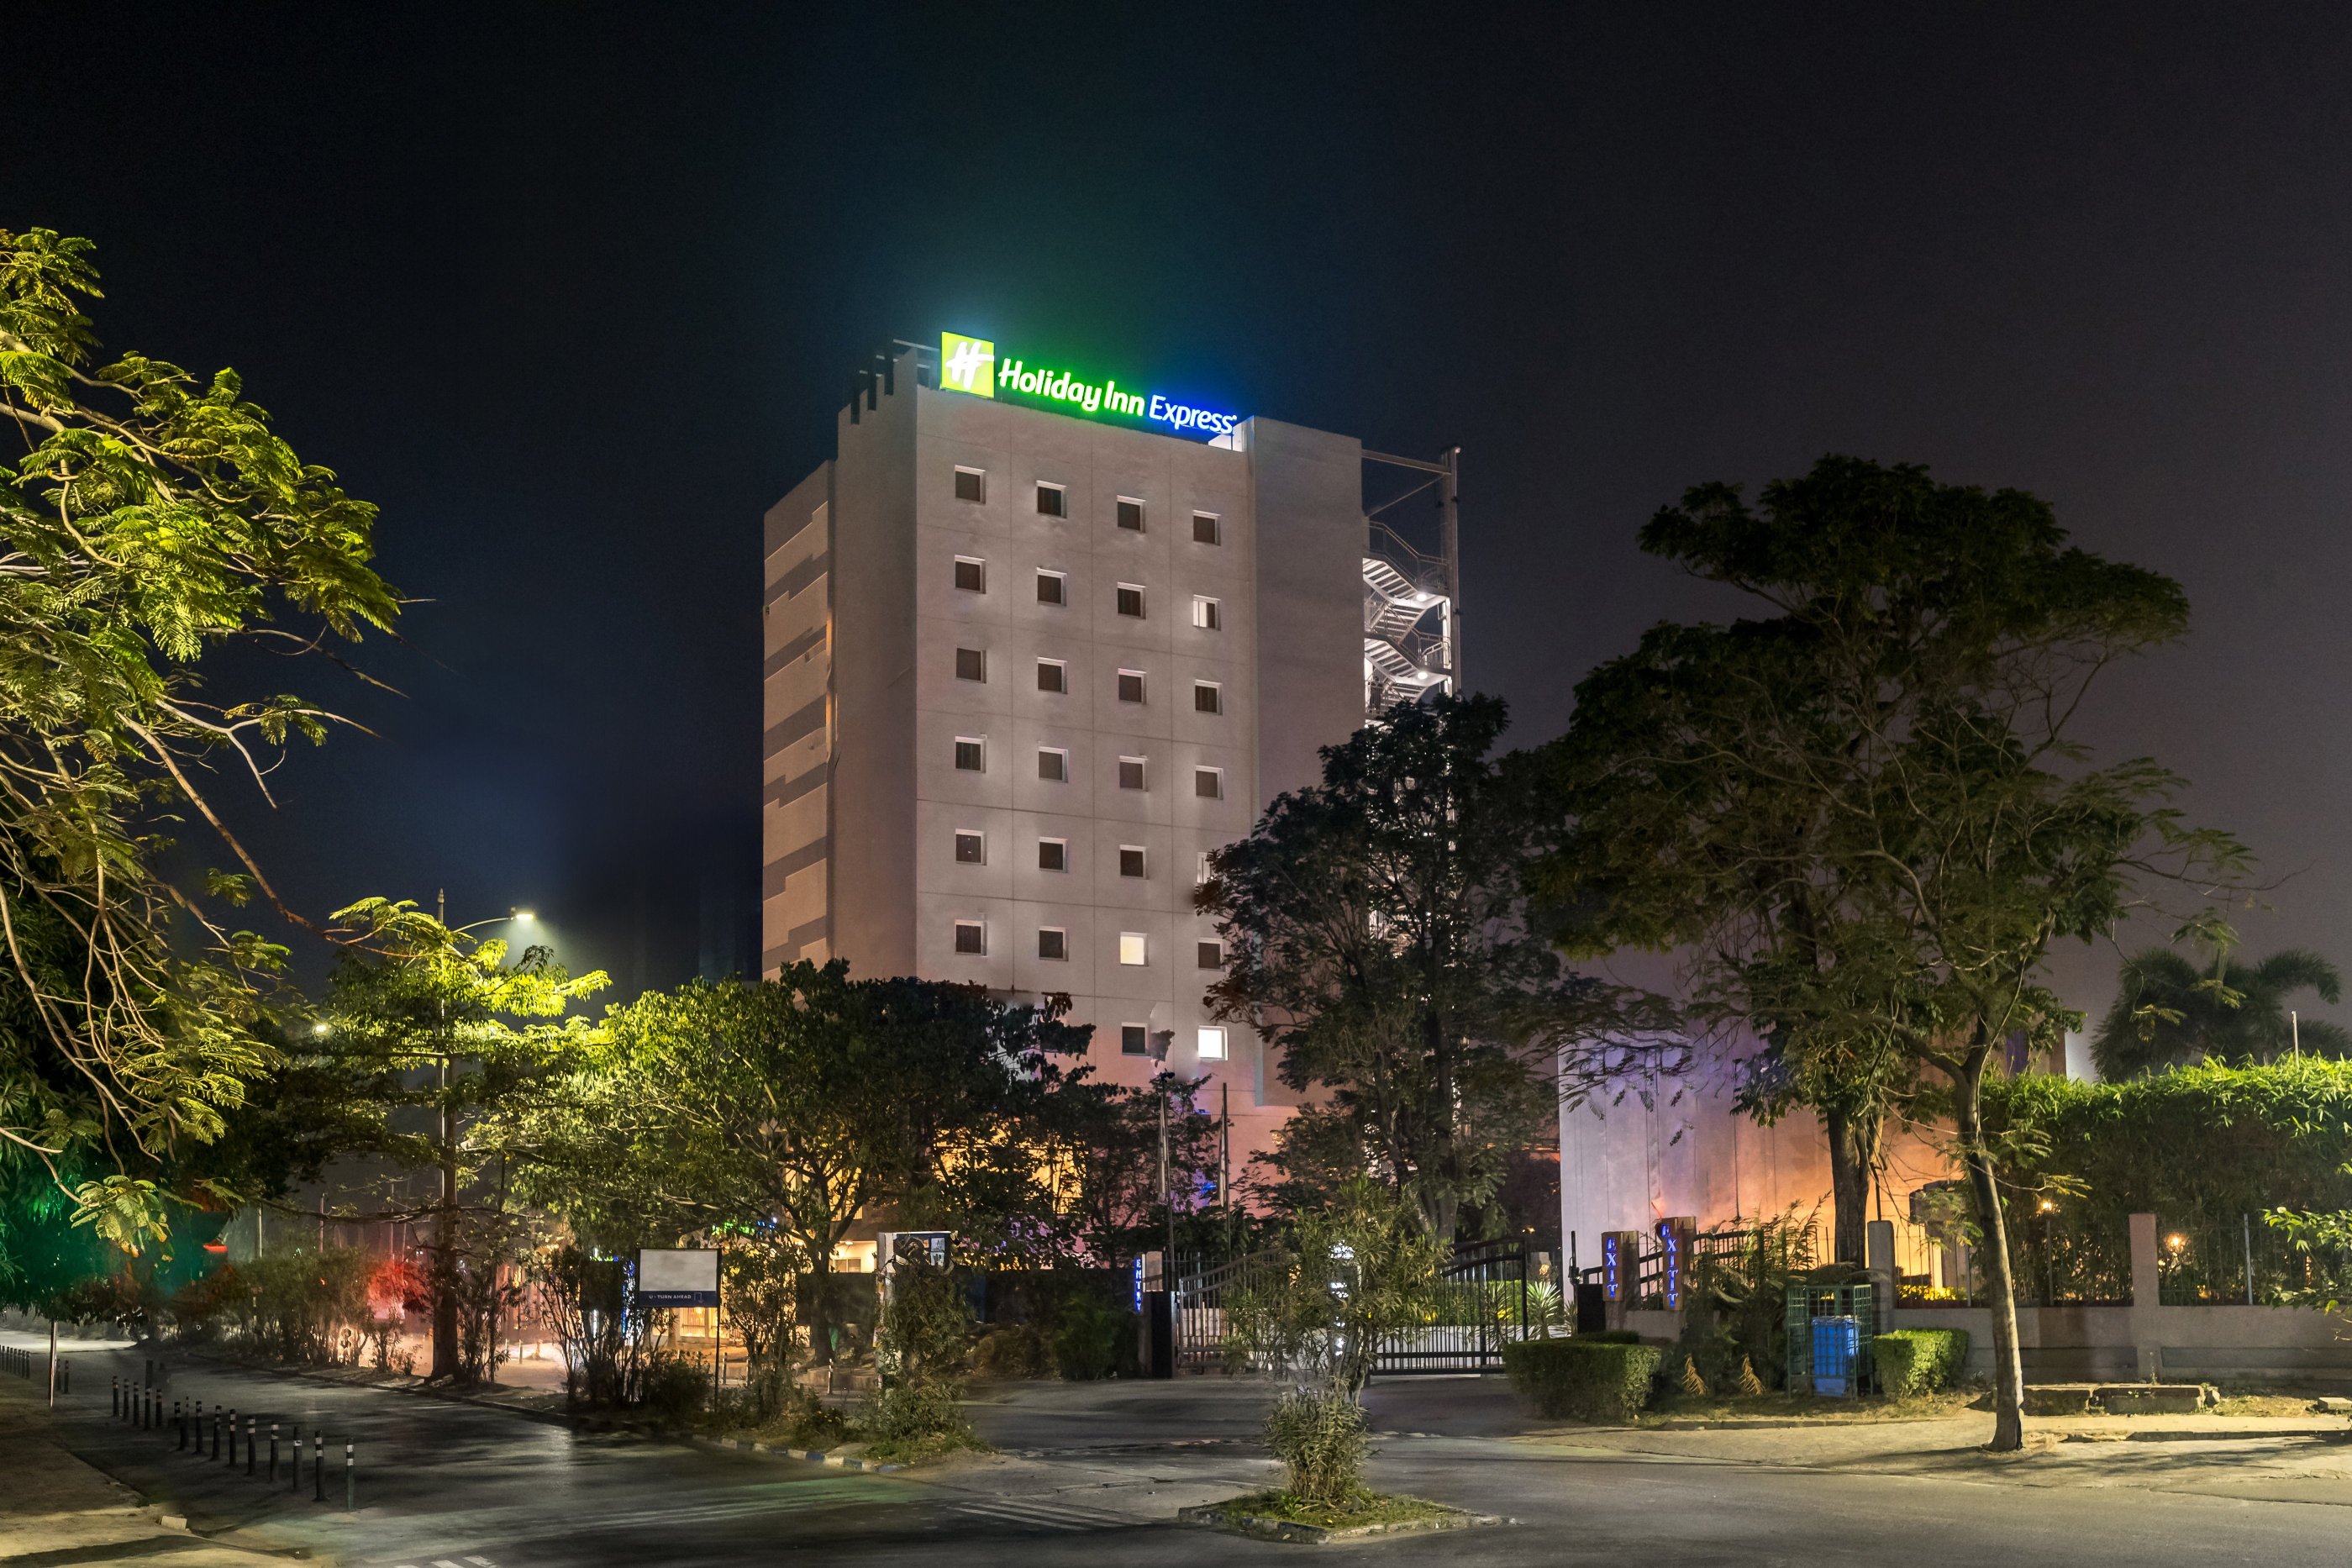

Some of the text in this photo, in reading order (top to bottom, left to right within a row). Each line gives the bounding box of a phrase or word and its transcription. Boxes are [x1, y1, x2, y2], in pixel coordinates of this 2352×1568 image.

[998, 358, 1234, 434] Holiday Inn Express
[1606, 1237, 1618, 1298] EXIT
